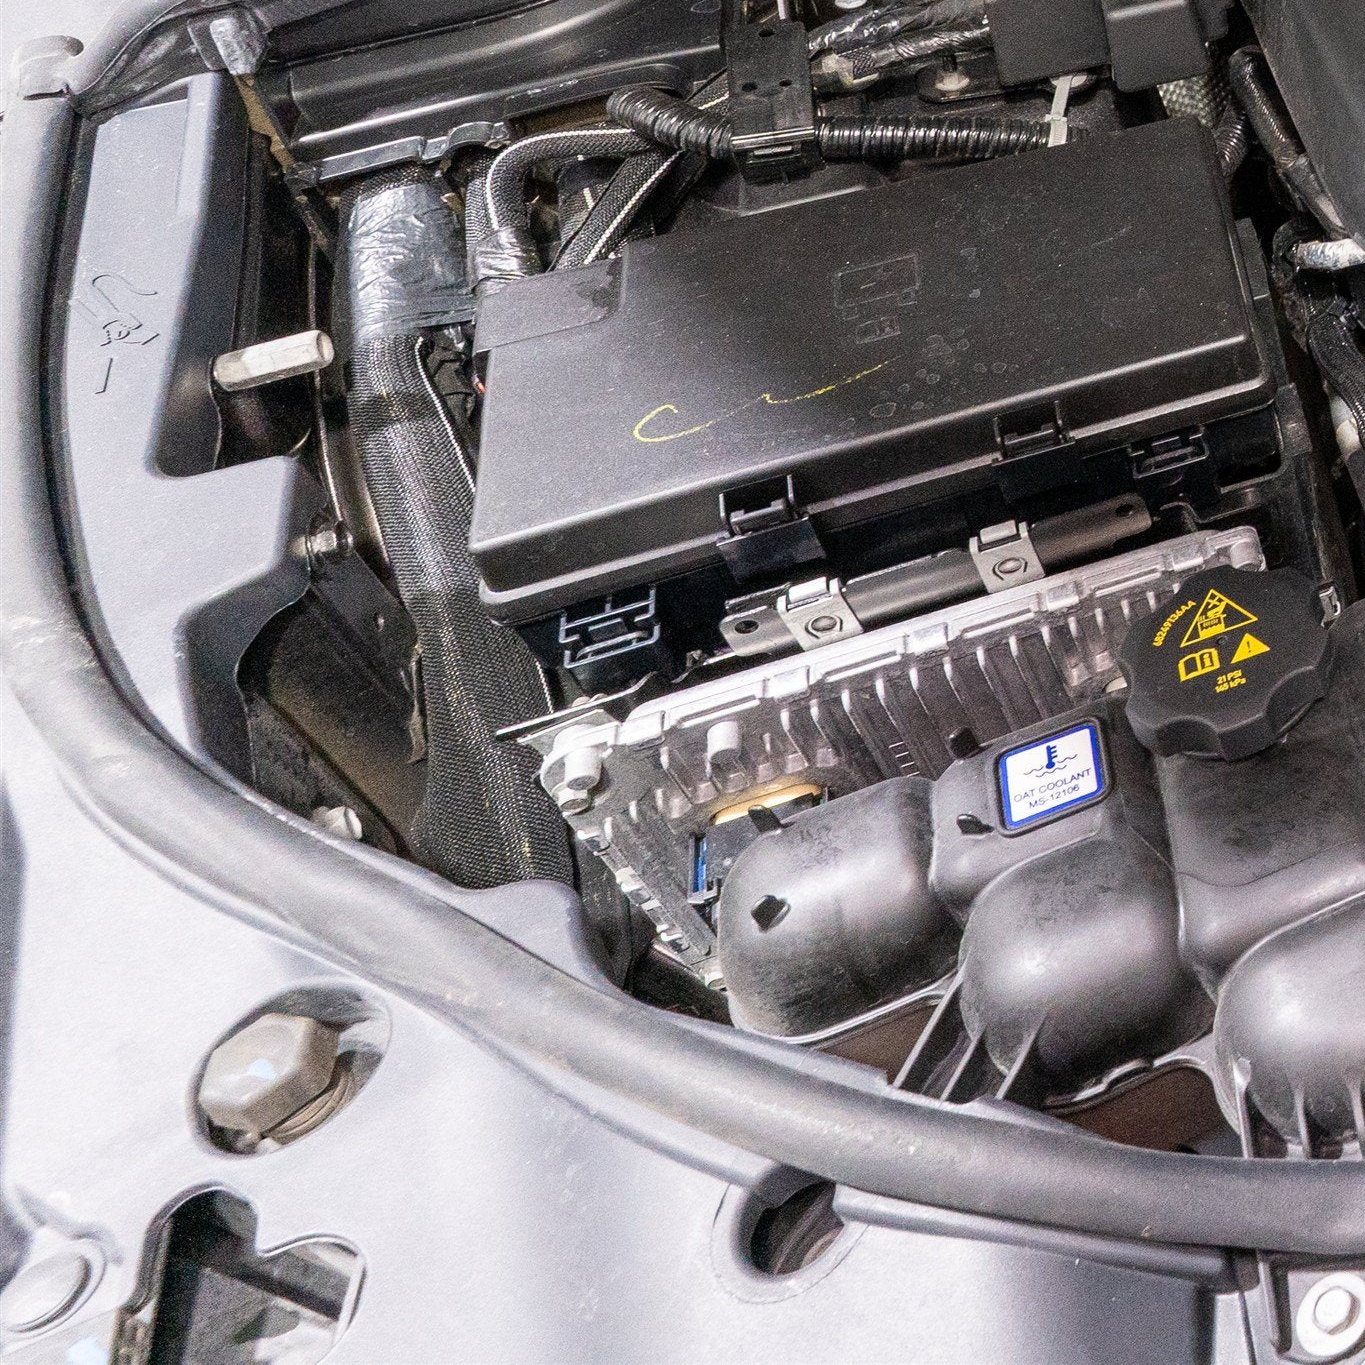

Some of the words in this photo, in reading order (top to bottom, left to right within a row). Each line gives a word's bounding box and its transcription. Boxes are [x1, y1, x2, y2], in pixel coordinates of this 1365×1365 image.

[1013, 788, 1036, 803] OAT
[1038, 767, 1092, 794] COOLANT
[1028, 784, 1080, 809] MS-12106
